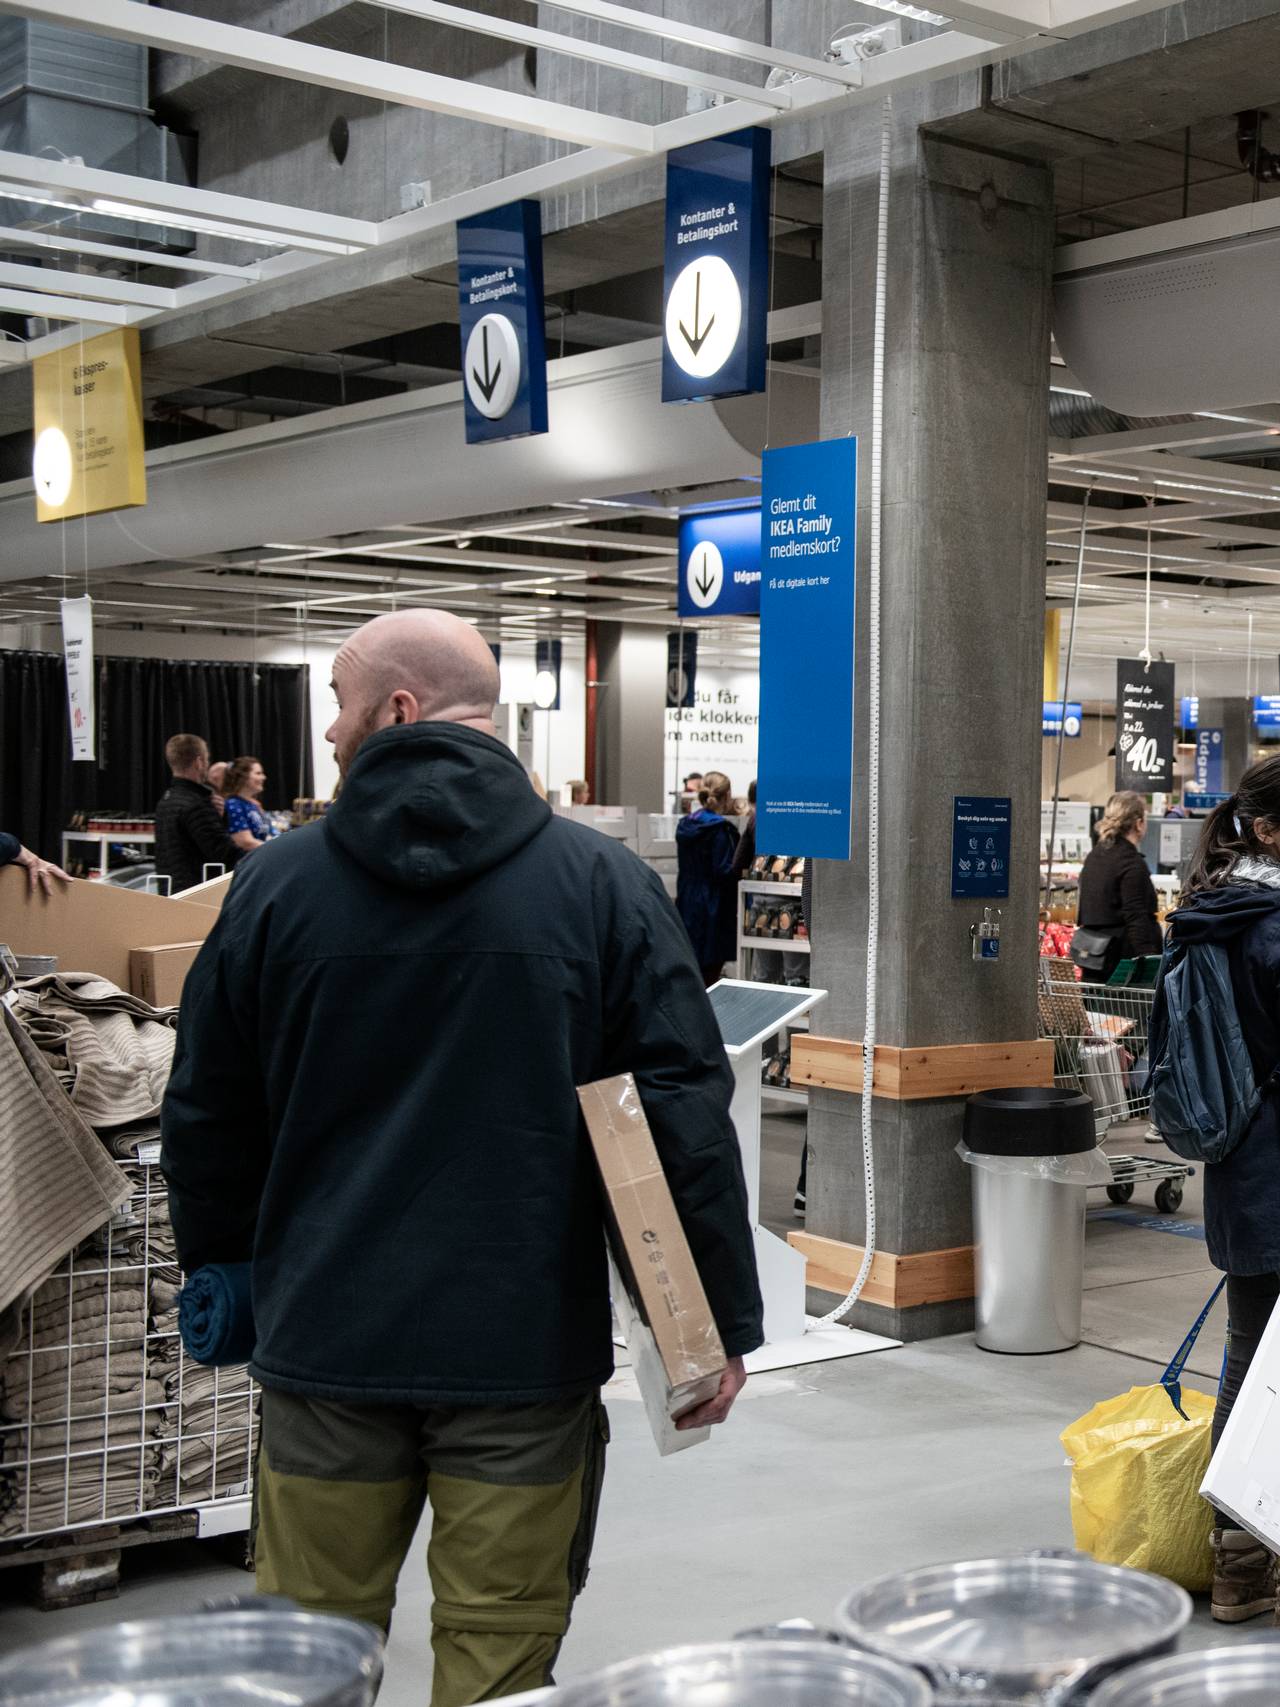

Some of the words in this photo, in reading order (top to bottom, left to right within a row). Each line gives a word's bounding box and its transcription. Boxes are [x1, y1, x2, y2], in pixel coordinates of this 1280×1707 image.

[680, 207, 726, 227] Kontanter
[727, 202, 736, 215] &
[677, 219, 739, 245] Betalingskort
[471, 270, 507, 289] Kontanter
[507, 266, 515, 278] &
[469, 281, 518, 305] Betalingskort
[770, 497, 800, 515] Glemt
[802, 494, 817, 511] dit
[770, 518, 795, 536] IKEA
[796, 514, 832, 535] Family
[769, 535, 841, 559] medlemskort?
[734, 570, 761, 585] Udgan
[769, 576, 777, 589] Få
[777, 577, 785, 588] dit
[786, 577, 806, 590] digitale
[806, 576, 819, 587] kort
[820, 575, 830, 585] her
[689, 731, 744, 744] natten
[1197, 731, 1210, 793] Udgan
